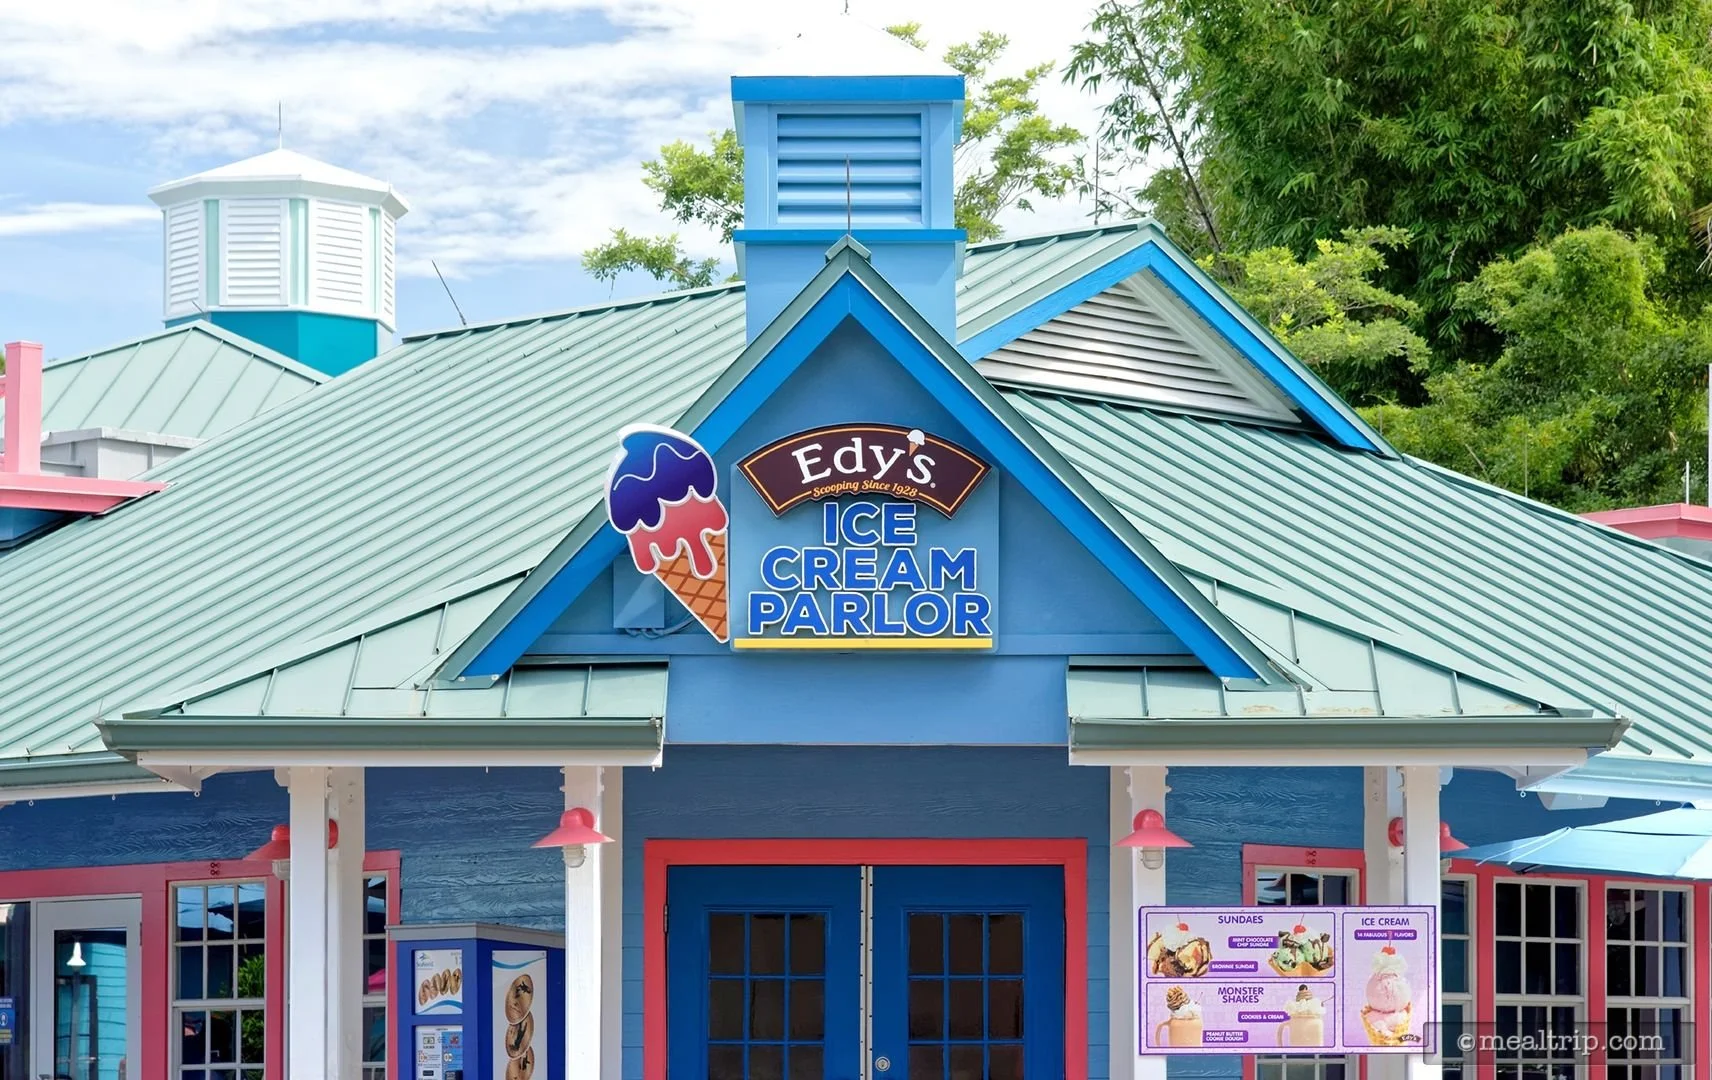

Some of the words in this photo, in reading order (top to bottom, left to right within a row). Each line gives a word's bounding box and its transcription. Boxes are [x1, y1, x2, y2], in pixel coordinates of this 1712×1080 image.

[813, 480, 859, 497] Scooping
[862, 480, 891, 491] Since
[892, 482, 918, 497] 1928
[823, 502, 917, 546] ICE
[760, 546, 977, 591] CREAM
[748, 591, 993, 636] PARLOR
[1218, 915, 1264, 924] SUNDAES
[1361, 918, 1375, 926] ICE
[1378, 918, 1410, 926] CREAM
[1217, 987, 1264, 996] MONSTER
[1222, 995, 1260, 1004] SHAKES
